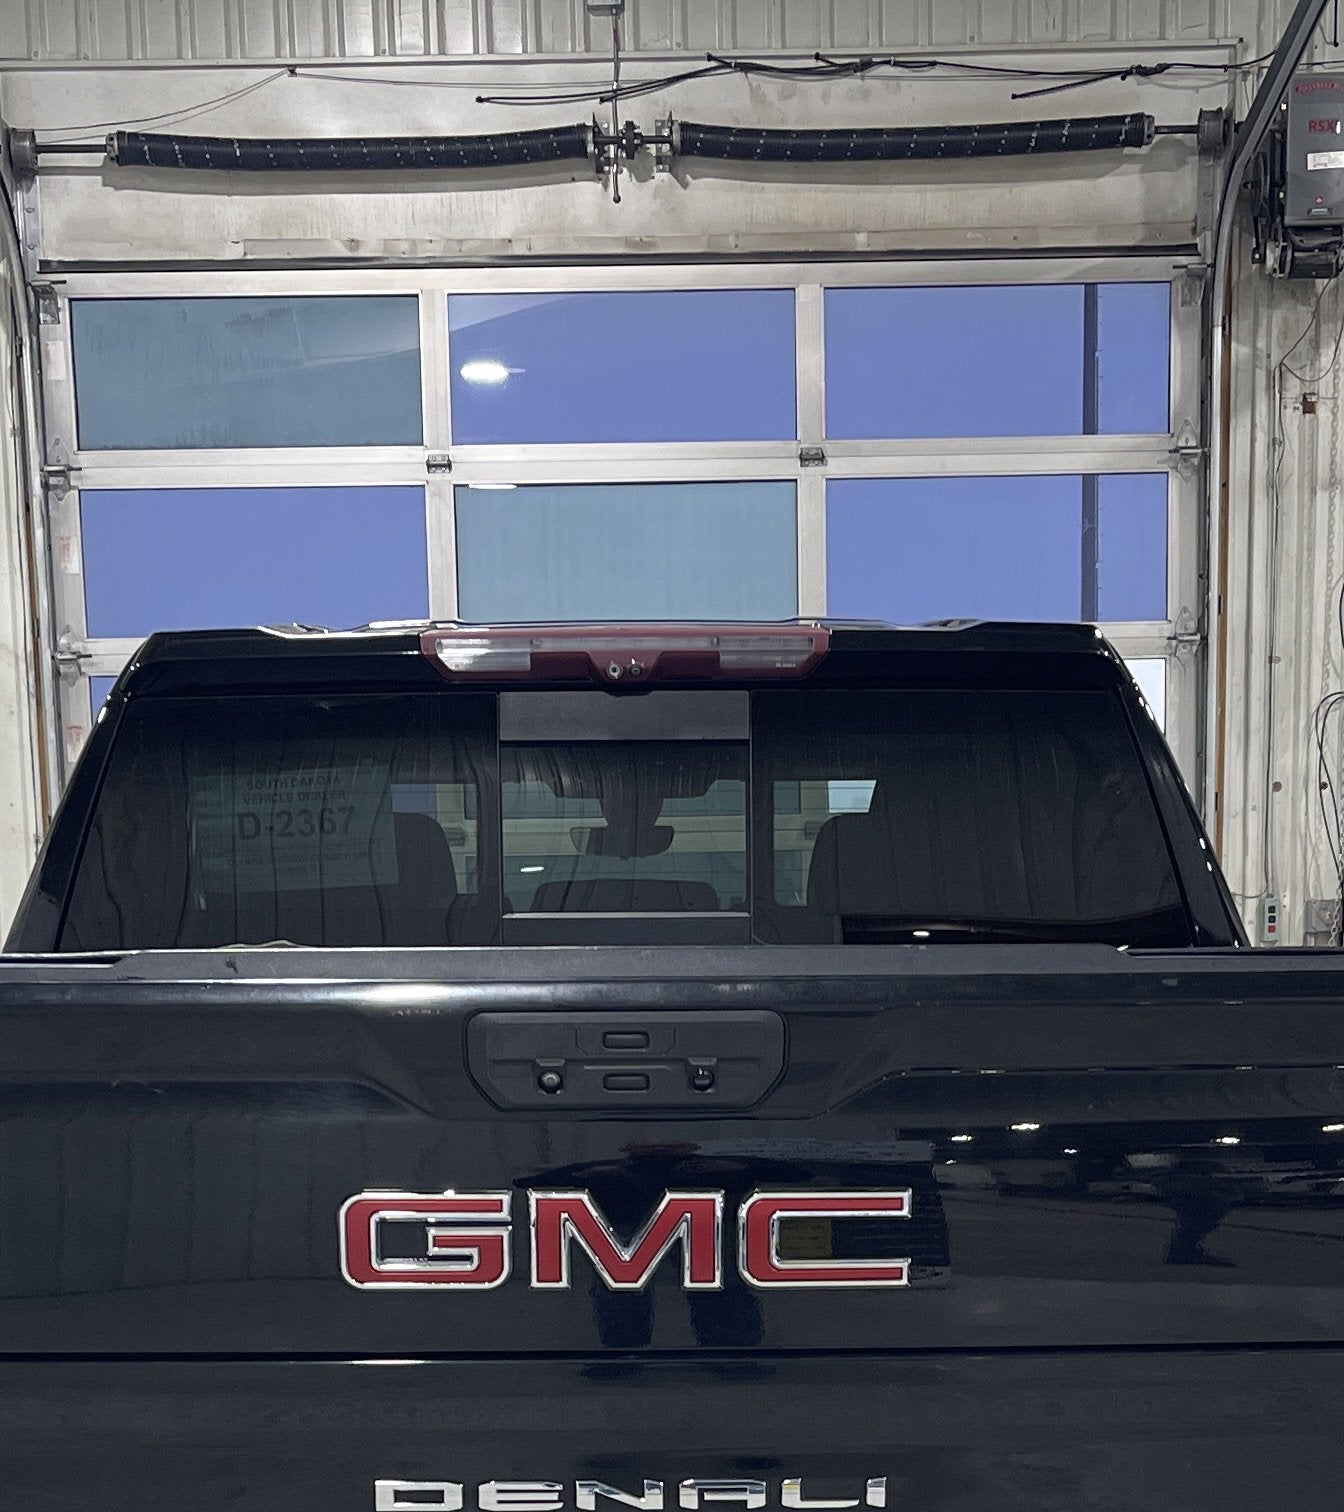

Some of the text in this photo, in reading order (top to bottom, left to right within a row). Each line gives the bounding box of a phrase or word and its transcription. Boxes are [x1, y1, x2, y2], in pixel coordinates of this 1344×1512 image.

[243, 792, 294, 806] VEHICLE
[246, 778, 288, 792] SOUTH
[236, 805, 356, 841] D-2367
[336, 1188, 913, 1290] GMC
[373, 1476, 888, 1512] DENALI
